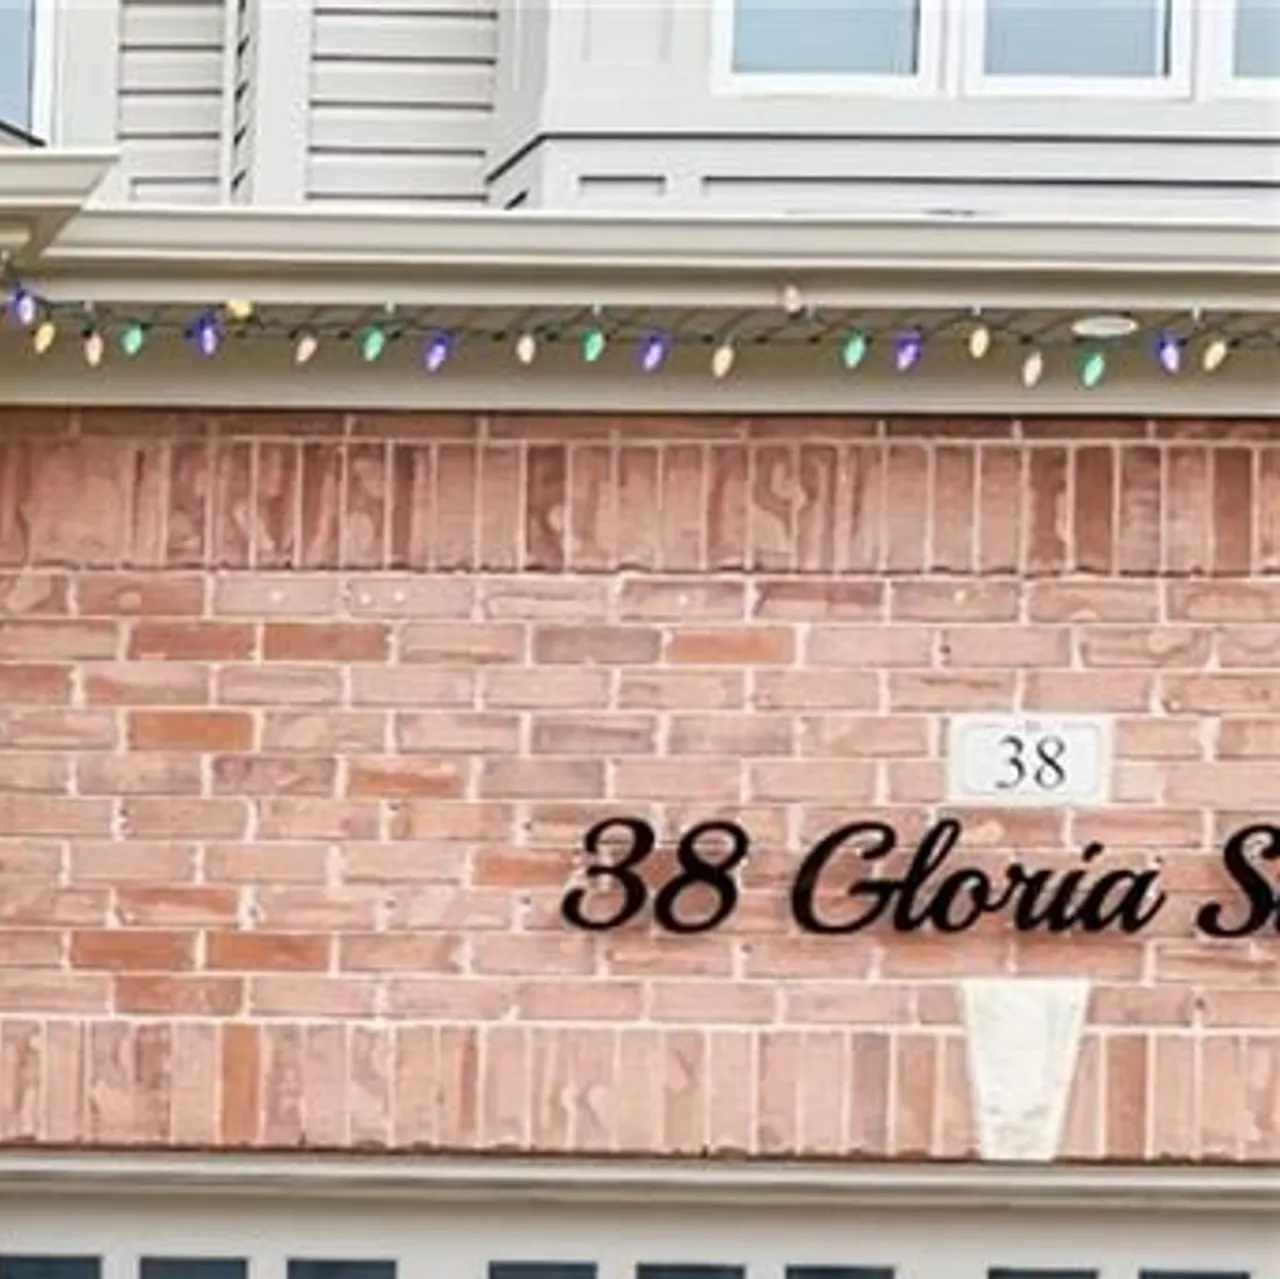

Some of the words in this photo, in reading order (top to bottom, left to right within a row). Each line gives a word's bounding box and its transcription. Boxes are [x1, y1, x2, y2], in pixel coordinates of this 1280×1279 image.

[995, 733, 1066, 790] 38
[561, 816, 749, 934] 38
[792, 816, 1167, 934] Gloria
[1196, 823, 1280, 938] S
